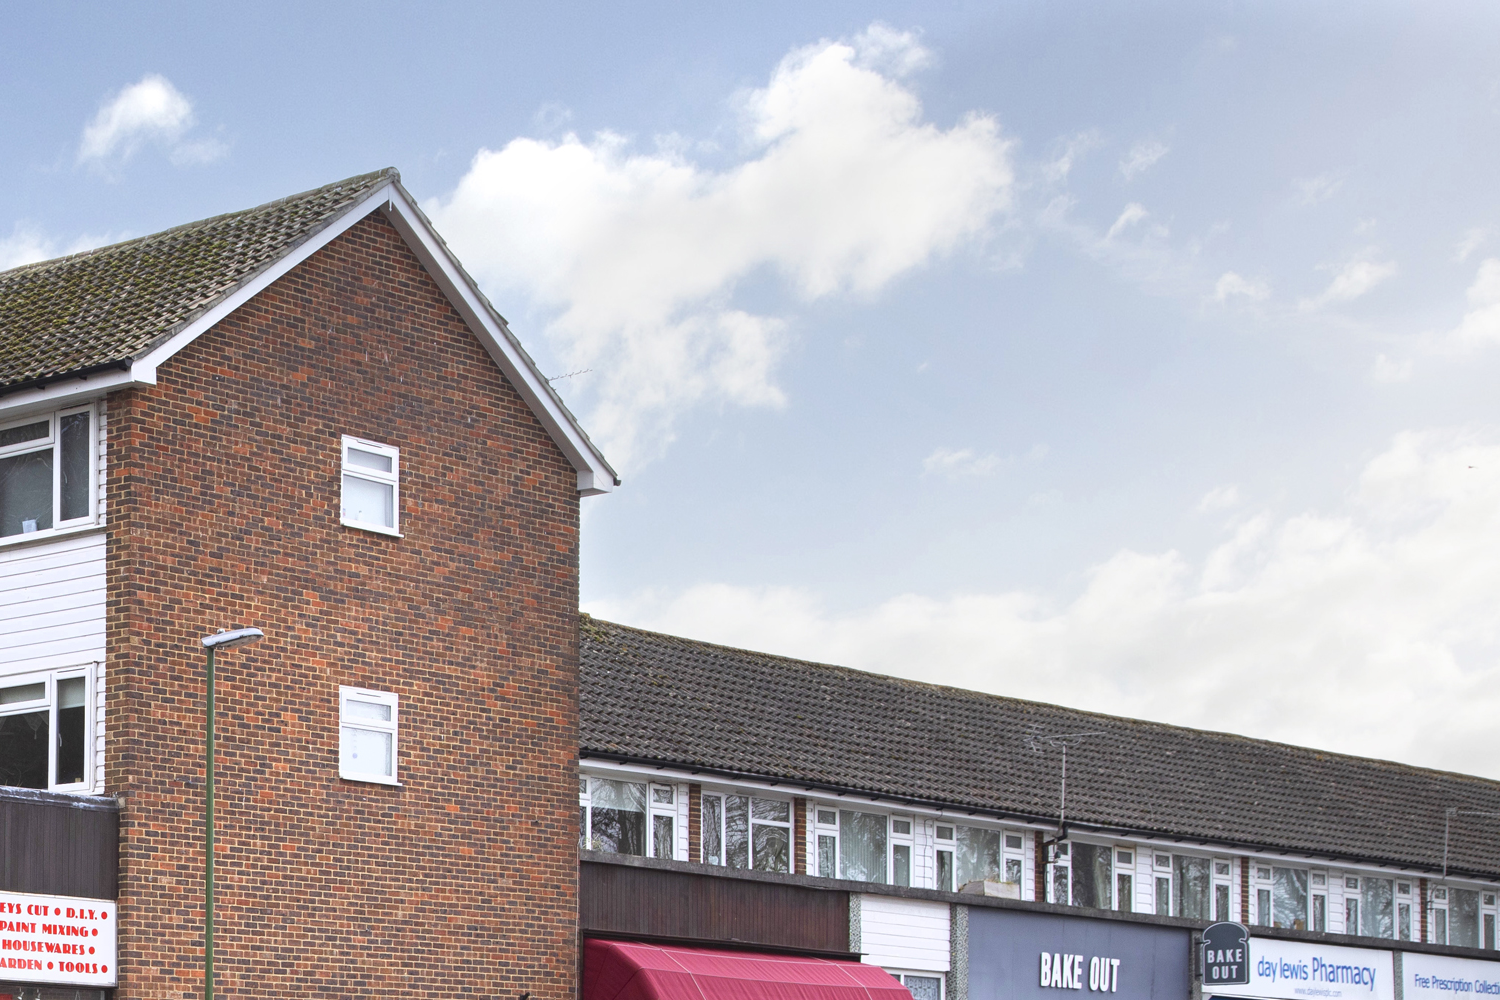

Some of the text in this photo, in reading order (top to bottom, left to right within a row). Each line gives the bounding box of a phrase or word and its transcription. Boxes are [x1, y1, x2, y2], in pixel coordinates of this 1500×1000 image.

[27, 904, 49, 916] CUT
[66, 908, 98, 920] D.I.Y.
[42, 924, 88, 937] MIXING
[2, 939, 85, 955] HOUSEWARES
[1206, 949, 1243, 963] BAKE
[59, 961, 98, 974] TOOLS
[1040, 952, 1120, 992] BAKE OUT
[1212, 965, 1238, 980] OUT
[1257, 956, 1376, 992] day lewis Pharmacy
[1414, 974, 1430, 988] Free
[1432, 975, 1473, 994] Prescription
